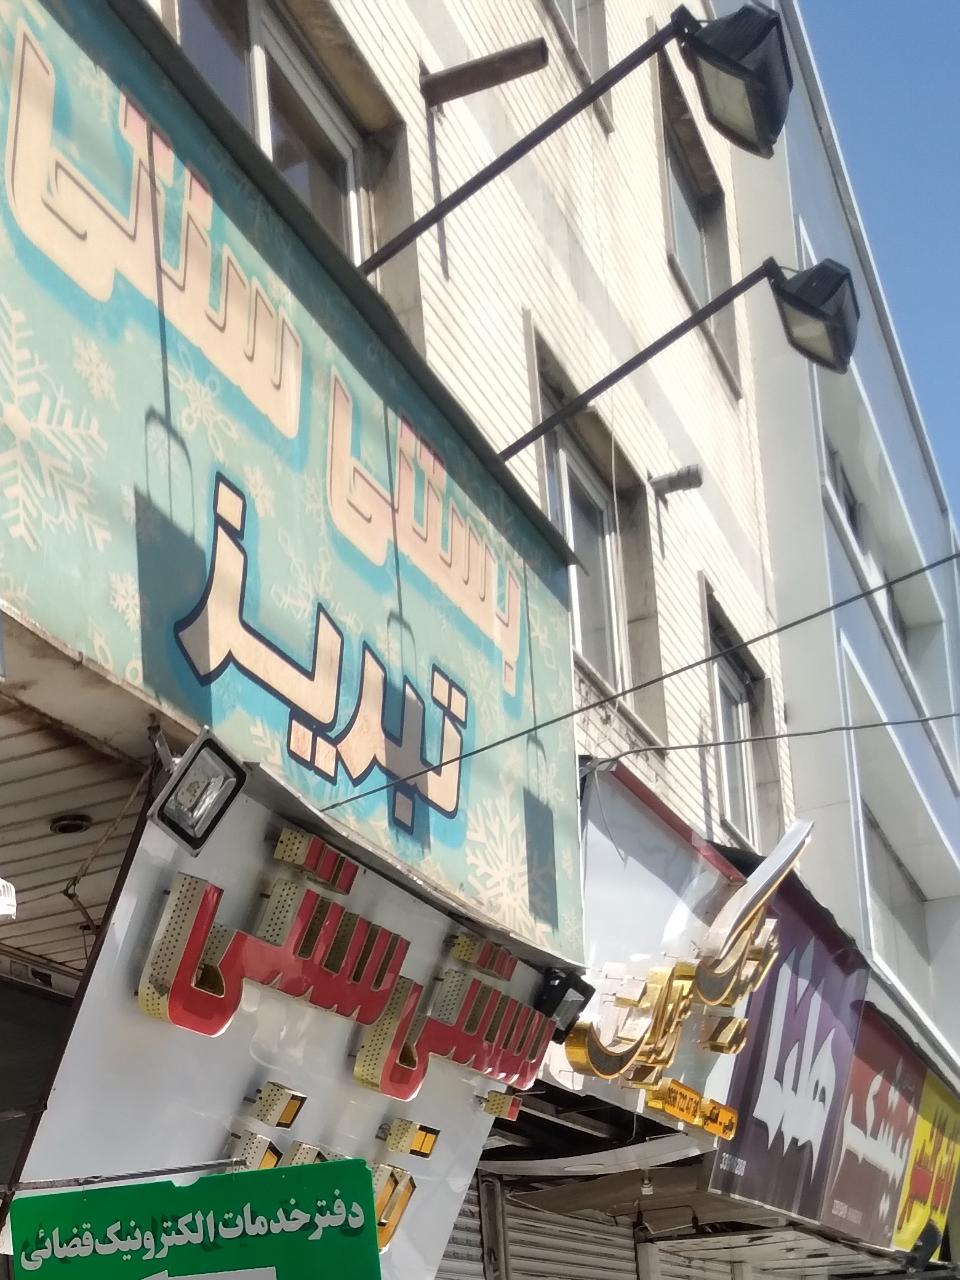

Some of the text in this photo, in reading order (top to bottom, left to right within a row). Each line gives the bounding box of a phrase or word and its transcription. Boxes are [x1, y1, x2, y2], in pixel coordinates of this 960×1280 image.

[8, 18, 523, 694] بستنی سنتی
[174, 472, 468, 834] تبریز
[140, 827, 411, 1038] سنتی
[354, 932, 558, 1121] بستنی
[20, 1188, 365, 1271] دفتر خدمات الکترونیک قضائی
